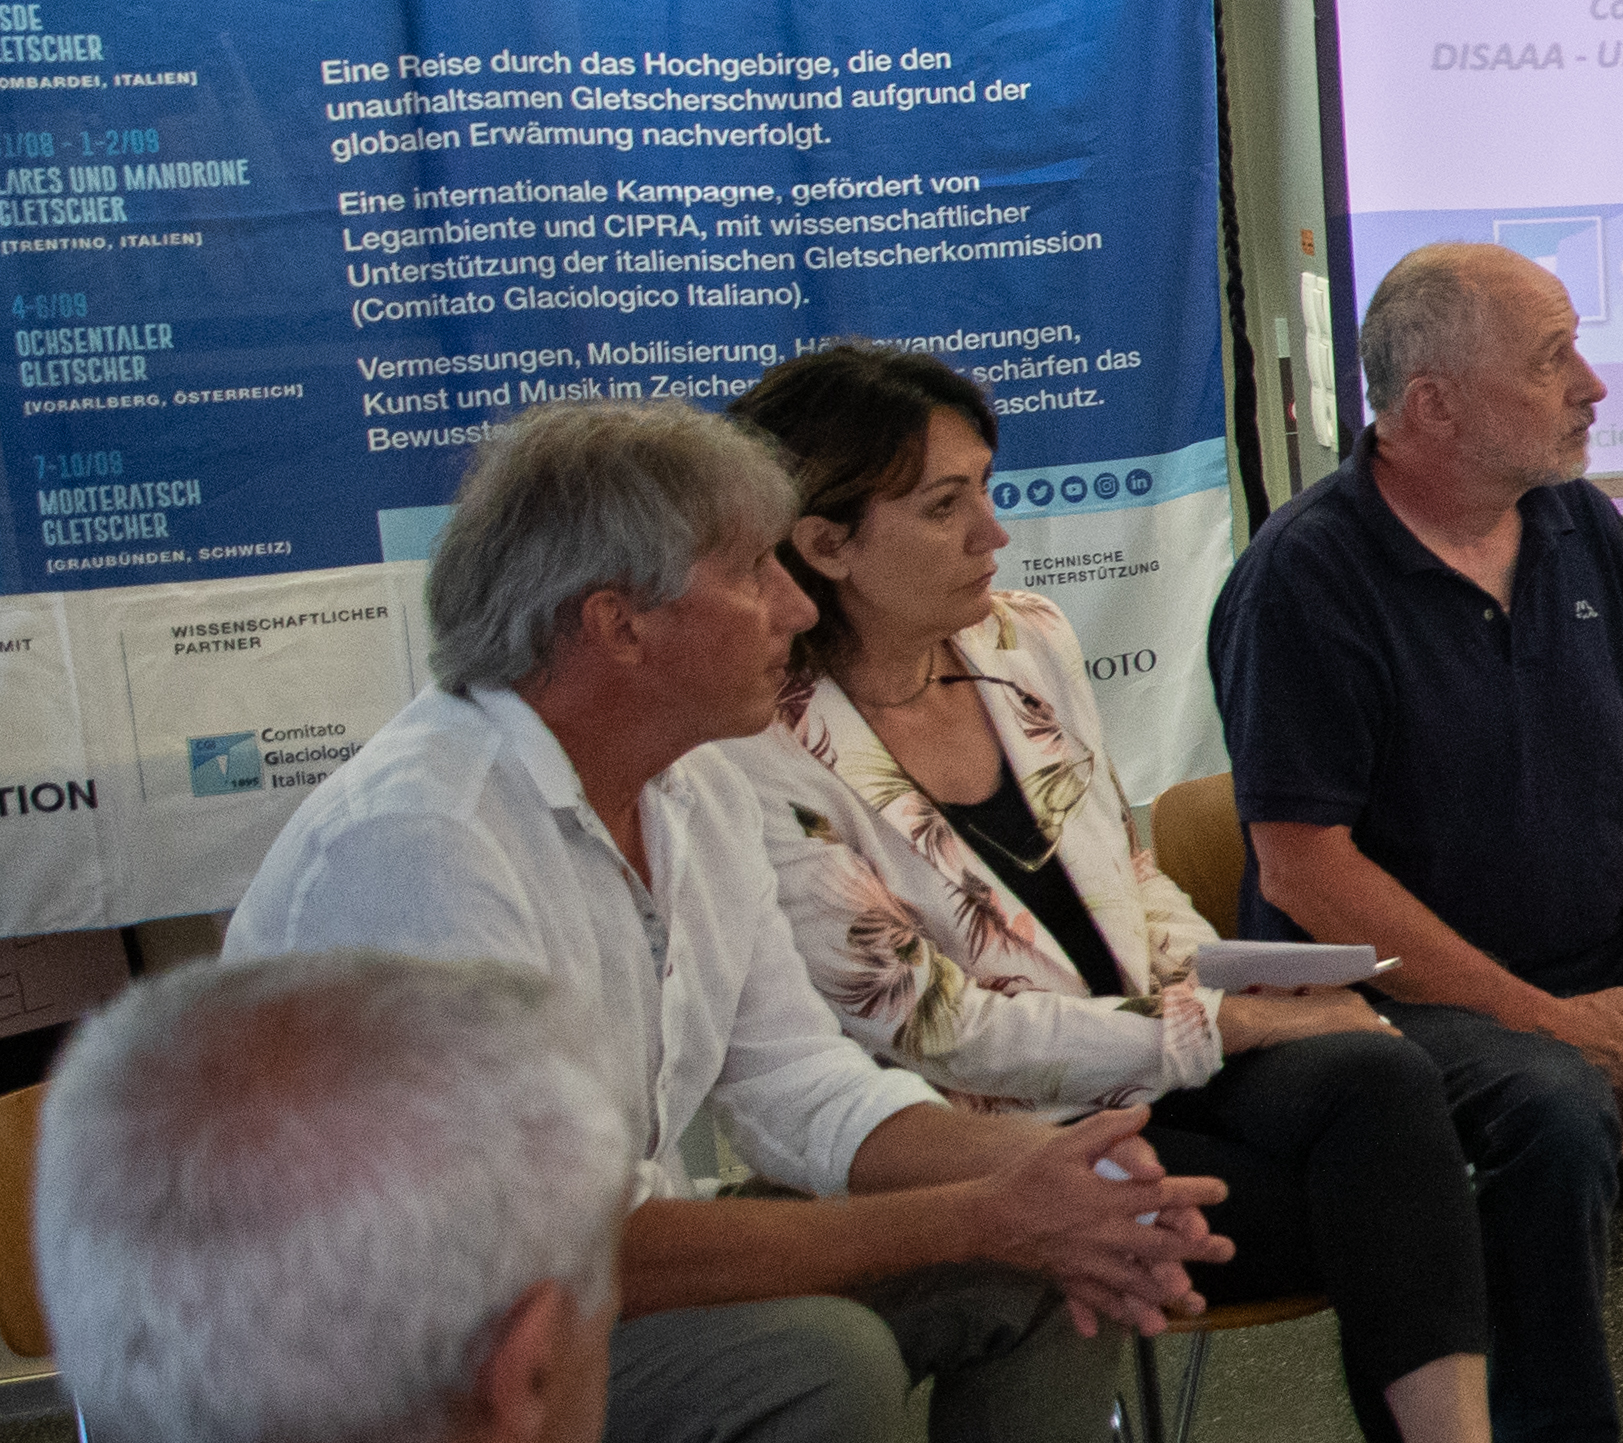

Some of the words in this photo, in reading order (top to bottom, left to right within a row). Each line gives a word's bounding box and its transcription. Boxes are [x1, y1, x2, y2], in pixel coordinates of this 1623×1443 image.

[321, 58, 391, 86] Eine
[399, 55, 480, 81] Reise
[490, 49, 573, 76] durch
[581, 51, 636, 77] das
[644, 48, 841, 83] Hochgebirge,
[848, 50, 893, 74] die
[900, 48, 952, 72] den
[1430, 41, 1566, 72] DISAAA
[113, 71, 199, 87] ITALIEN]
[326, 88, 564, 122] unaufhaltsamen
[571, 86, 844, 113] Gletscherschwund
[851, 81, 977, 111] aufgrund
[984, 78, 1032, 103] der
[331, 128, 462, 164] globalen
[469, 121, 634, 156] Erwärmung
[642, 118, 832, 150] nachverfolgt.
[69, 165, 118, 194] UND
[123, 159, 251, 191] MANDRONE
[339, 190, 406, 218] Eine
[413, 180, 609, 213] internationale
[616, 176, 783, 208] Kampagne,
[791, 173, 923, 204] gefördert
[930, 172, 981, 194] von
[120, 232, 203, 250] ITALIEN]
[344, 215, 538, 256] Legambiente
[546, 213, 596, 242] und
[604, 211, 708, 242] CIPRA,
[716, 214, 762, 238] mit
[770, 201, 1032, 236] wissenschaftlicher
[348, 252, 557, 291] Unterstützung
[564, 252, 608, 276] der
[615, 246, 796, 274] italienischen
[804, 228, 1103, 270] Gletscherkommission
[352, 293, 496, 328] (Comitato
[504, 284, 680, 316] Glaciologico
[687, 281, 811, 312] Italiano).
[15, 323, 175, 357] OCHSENTALER
[20, 356, 149, 388] GLETSCHER
[358, 344, 582, 384] Vermessungen,
[588, 340, 785, 370] Mobilisierung,
[364, 388, 449, 416] Kunst
[457, 382, 512, 408] und
[519, 376, 602, 406] Musik
[609, 377, 642, 399] im
[972, 356, 1089, 385] schärfen
[1096, 349, 1141, 371] das
[38, 479, 202, 516] MORTERATSCH
[42, 513, 171, 547] GLETSCHER
[1022, 550, 1124, 572] TECHNISCHE
[1024, 560, 1160, 588] UNTERSTÜTZUNG
[171, 605, 390, 639] WISSENSCHAFTLICHER
[174, 635, 262, 656] PARTNER
[260, 722, 347, 744] Comitato
